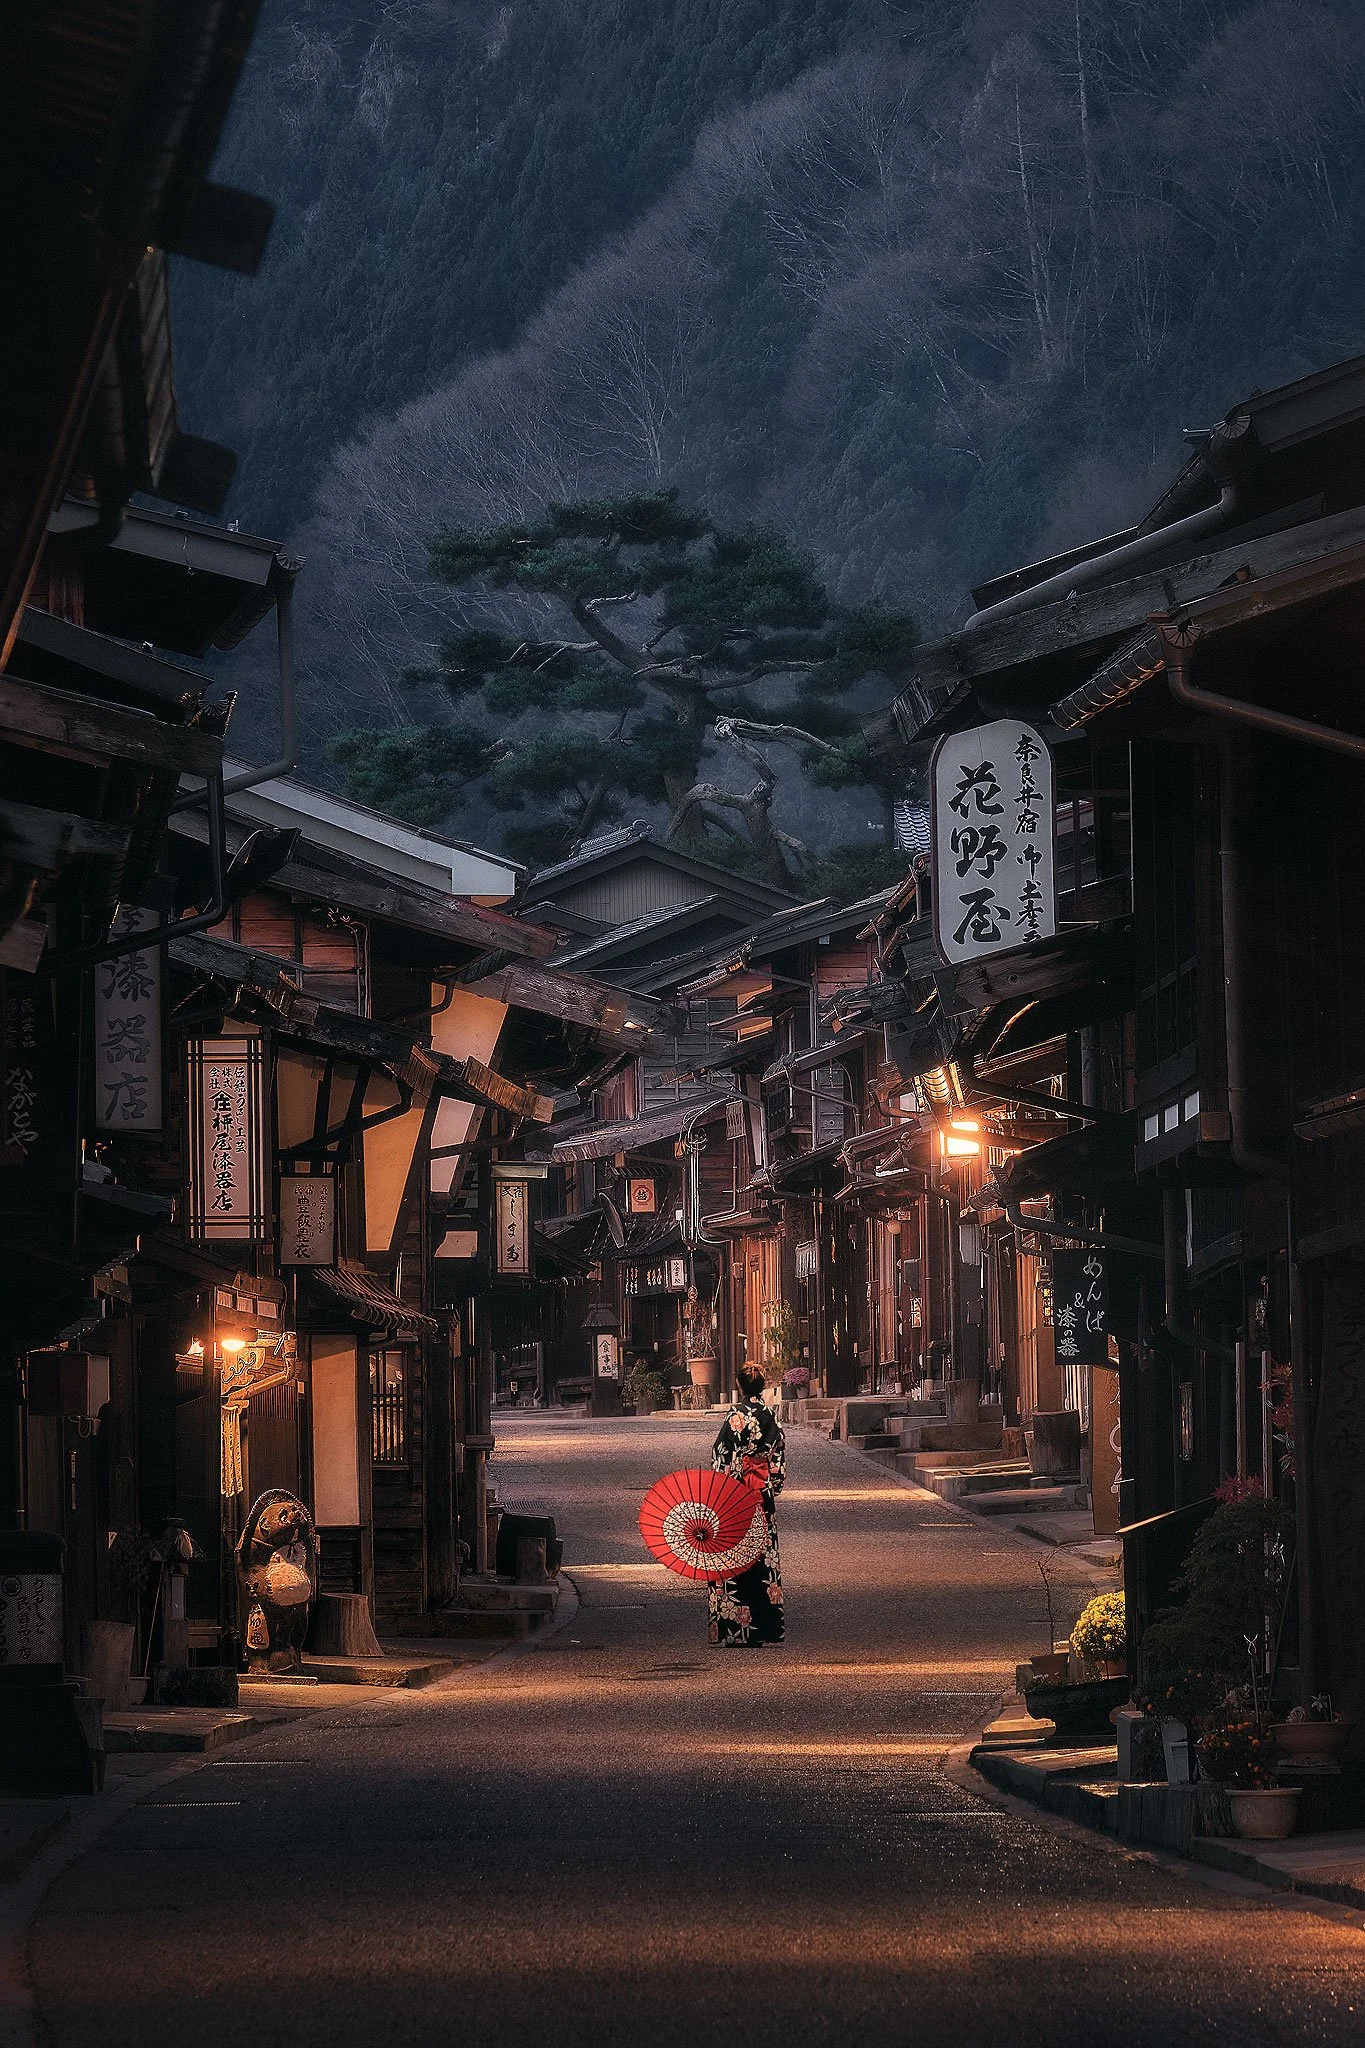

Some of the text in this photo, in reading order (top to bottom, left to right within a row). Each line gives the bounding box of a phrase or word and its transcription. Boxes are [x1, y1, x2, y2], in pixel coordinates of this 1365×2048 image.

[1012, 733, 1044, 835] 奈良井宿
[948, 760, 1011, 945] 花野屋
[4, 1066, 40, 1156] ながとや
[1056, 1303, 1080, 1358] 漆の器
[1073, 1292, 1086, 1309] &
